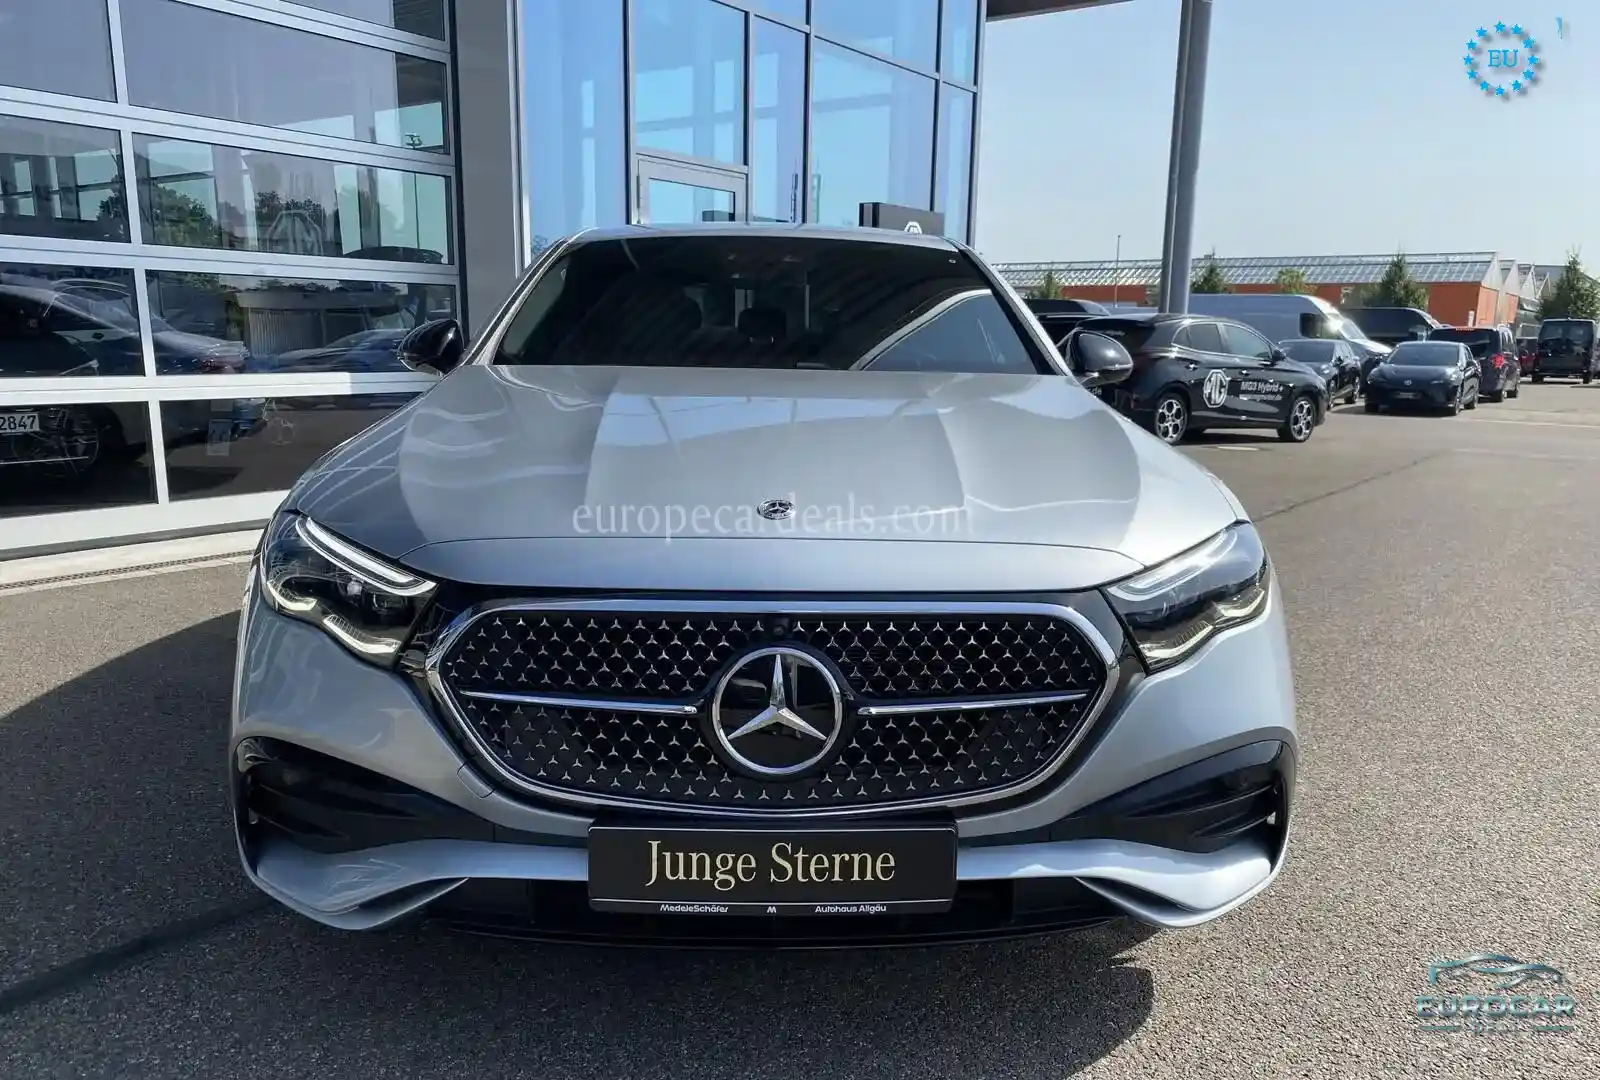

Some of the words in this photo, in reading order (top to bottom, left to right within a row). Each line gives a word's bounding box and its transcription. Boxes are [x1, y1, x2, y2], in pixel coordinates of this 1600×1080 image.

[1203, 369, 1229, 408] MG
[1240, 381, 1257, 391] MG3
[0, 415, 37, 431] 2847
[645, 840, 757, 891] Junge
[770, 842, 896, 883] Sterne
[815, 905, 858, 913] Autohaus
[858, 903, 887, 914] Allgäu
